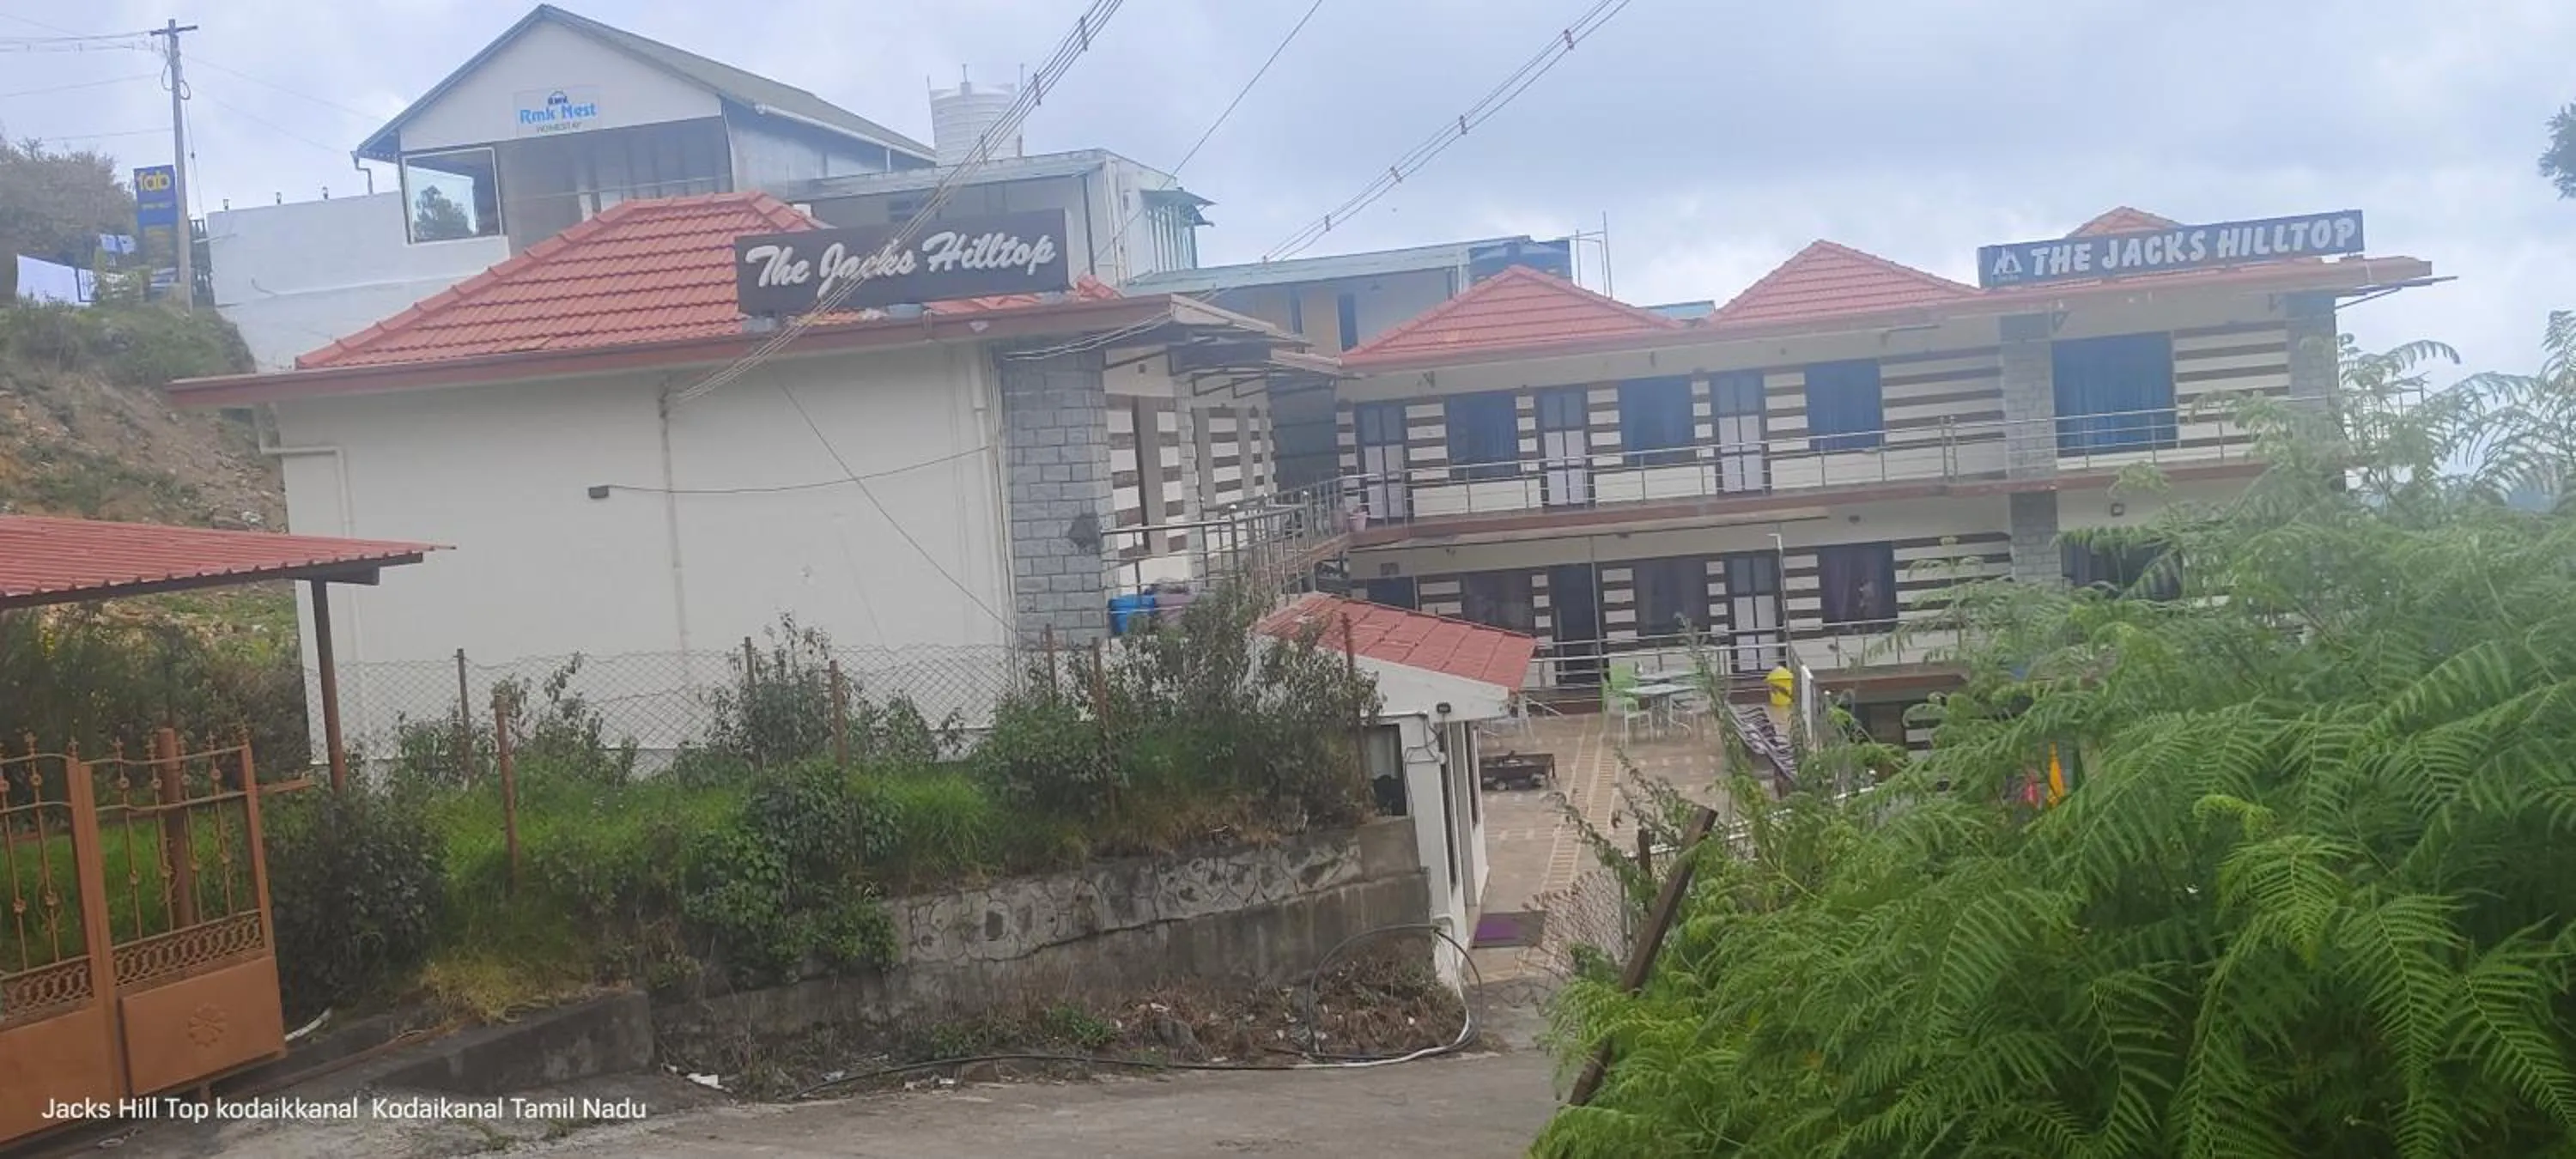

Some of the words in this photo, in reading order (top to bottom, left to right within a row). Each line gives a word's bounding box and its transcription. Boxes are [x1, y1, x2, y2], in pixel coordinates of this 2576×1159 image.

[519, 106, 556, 124] Rmk
[562, 102, 597, 119] Nest
[137, 170, 171, 192] fab
[745, 245, 811, 288] The
[817, 240, 917, 299] Jacks
[921, 231, 1057, 276] Hilltop
[2030, 242, 2092, 276] THE
[2101, 229, 2206, 270] JACKS
[2217, 217, 2356, 259] HILLTOP
